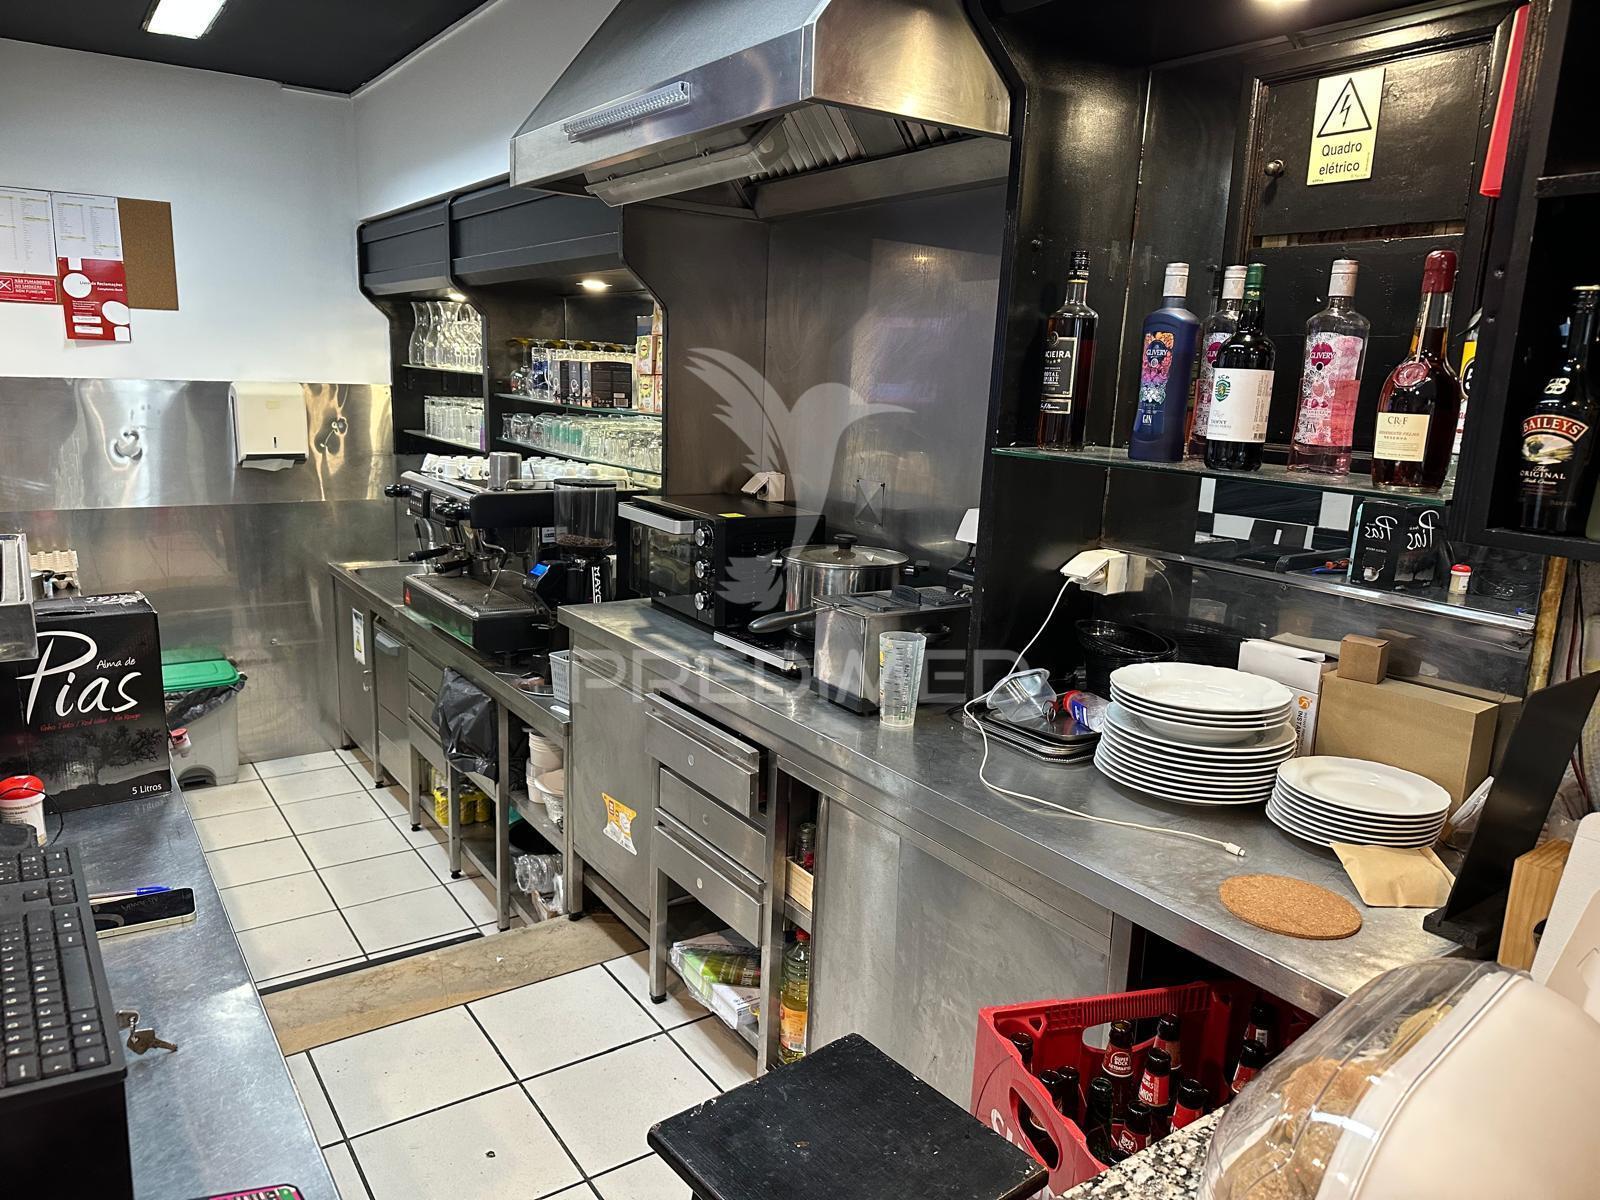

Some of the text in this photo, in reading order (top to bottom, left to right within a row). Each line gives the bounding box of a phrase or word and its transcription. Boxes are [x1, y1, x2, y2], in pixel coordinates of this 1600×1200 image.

[1322, 141, 1362, 157] Quadro
[1319, 161, 1360, 175] elétrico
[1523, 417, 1581, 435] BAILEYS
[1520, 470, 1566, 480] ORIGINAL
[97, 656, 136, 670] Alma de
[15, 630, 142, 725] Pias
[132, 782, 162, 795] 5 Litros
